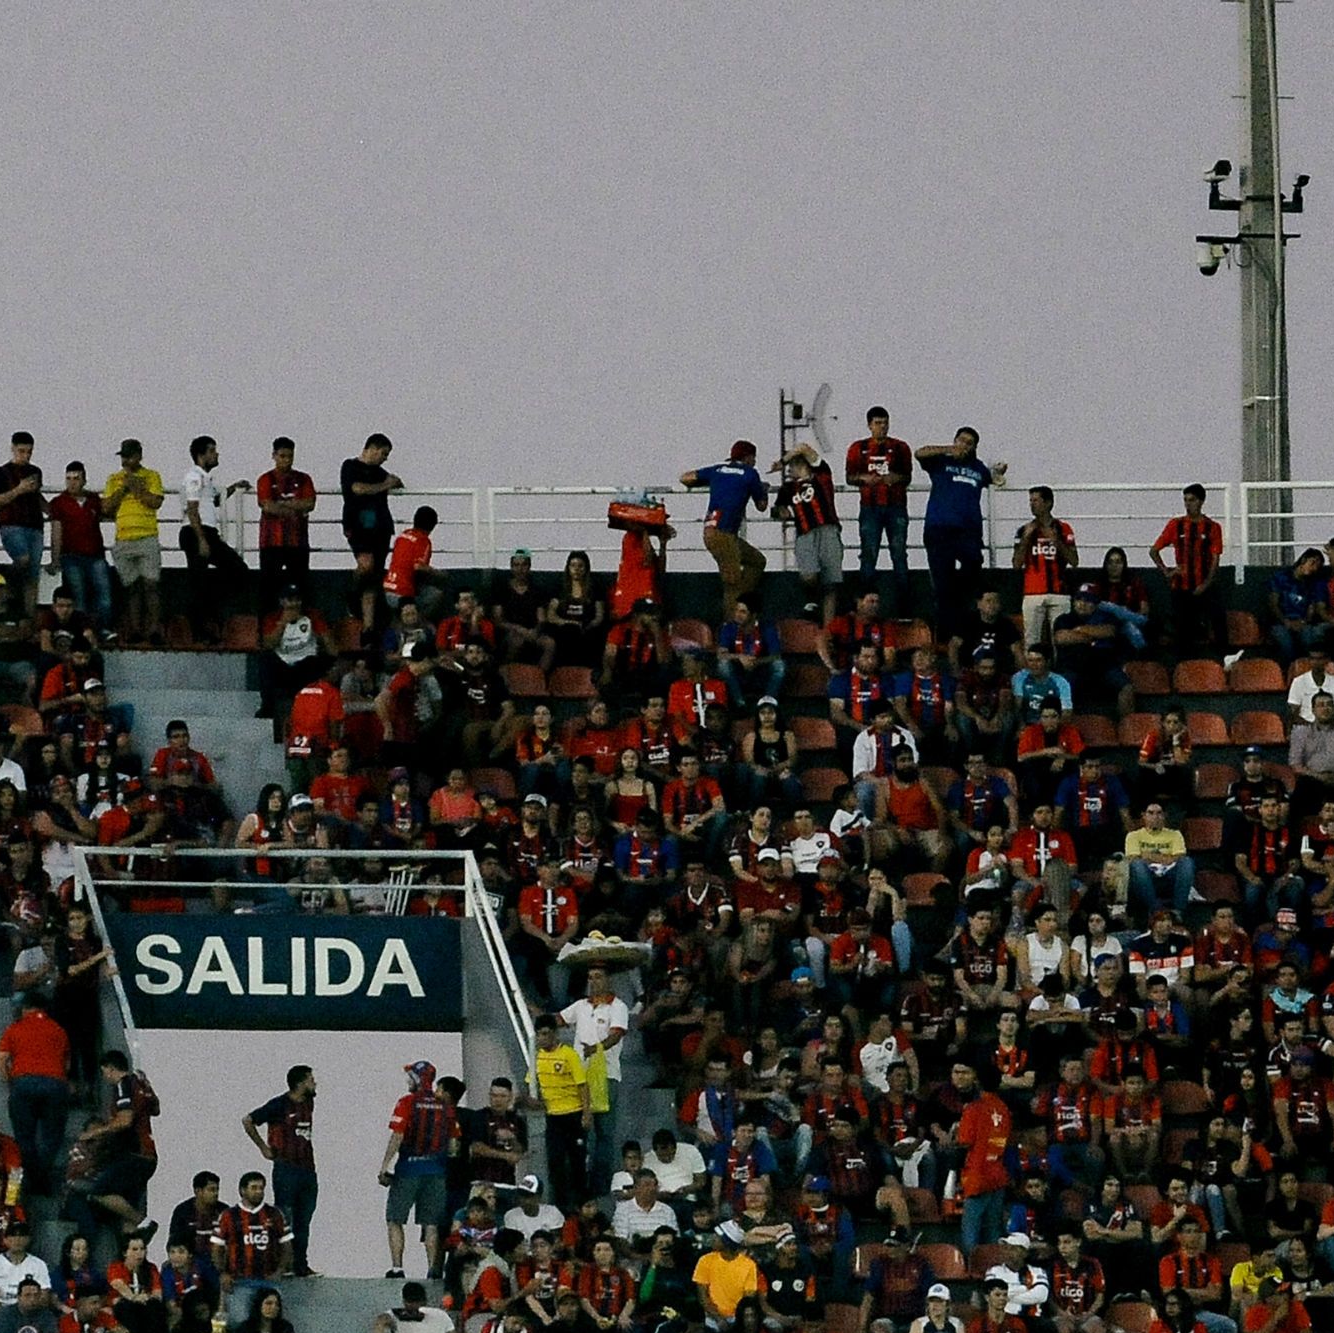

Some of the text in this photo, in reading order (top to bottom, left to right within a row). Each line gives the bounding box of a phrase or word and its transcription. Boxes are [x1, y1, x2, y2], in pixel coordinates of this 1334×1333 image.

[134, 934, 426, 998] SALIDA
[244, 1231, 269, 1250] tigo
[1060, 1285, 1084, 1302] tigo
